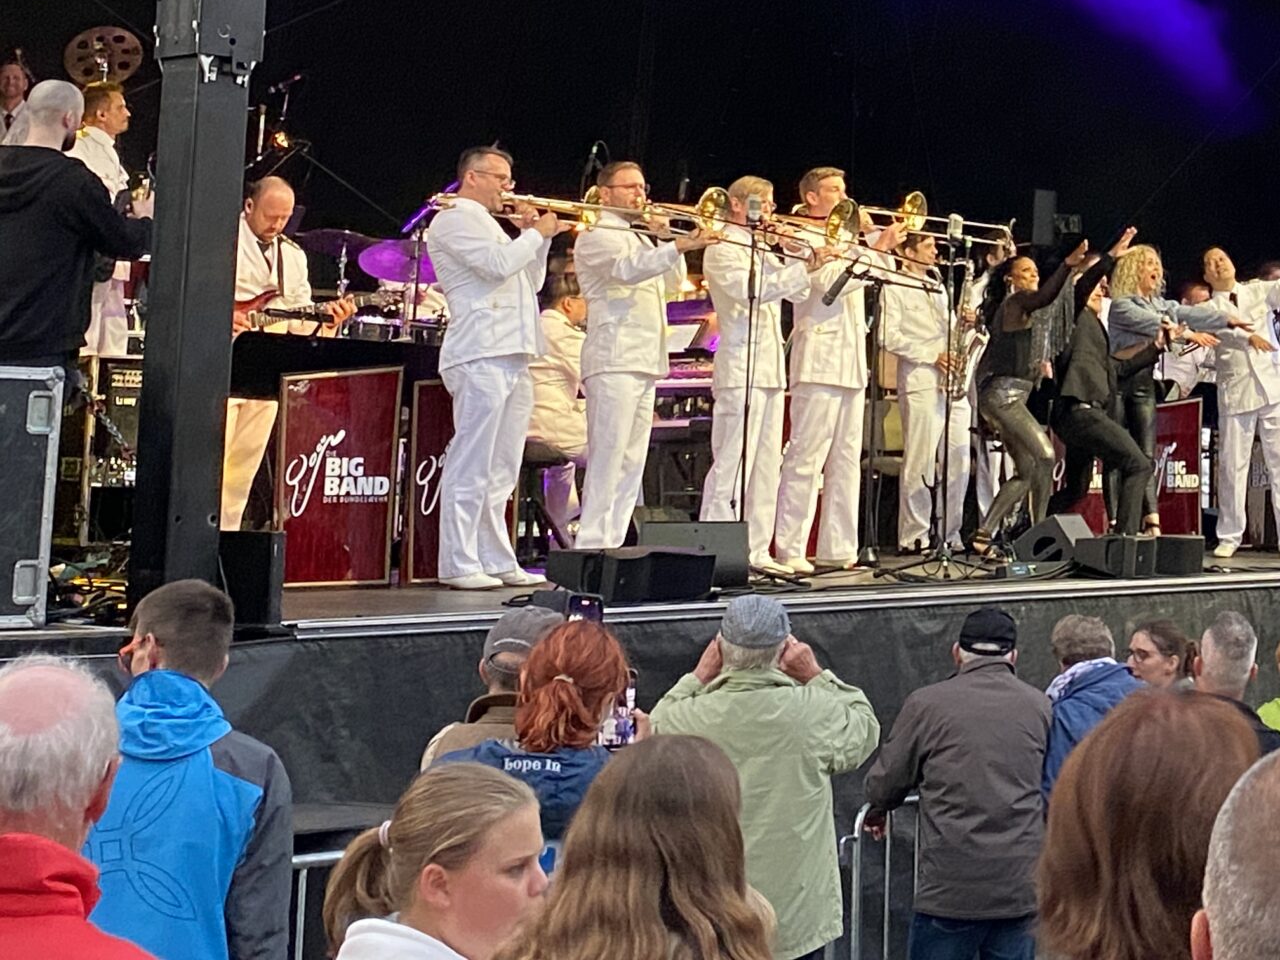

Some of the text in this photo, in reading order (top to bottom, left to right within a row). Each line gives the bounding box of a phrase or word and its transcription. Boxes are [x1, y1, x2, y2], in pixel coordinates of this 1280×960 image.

[325, 456, 365, 477] BIG
[1166, 460, 1187, 475] BIG
[323, 475, 390, 496] BAND
[1166, 474, 1199, 488] BAND
